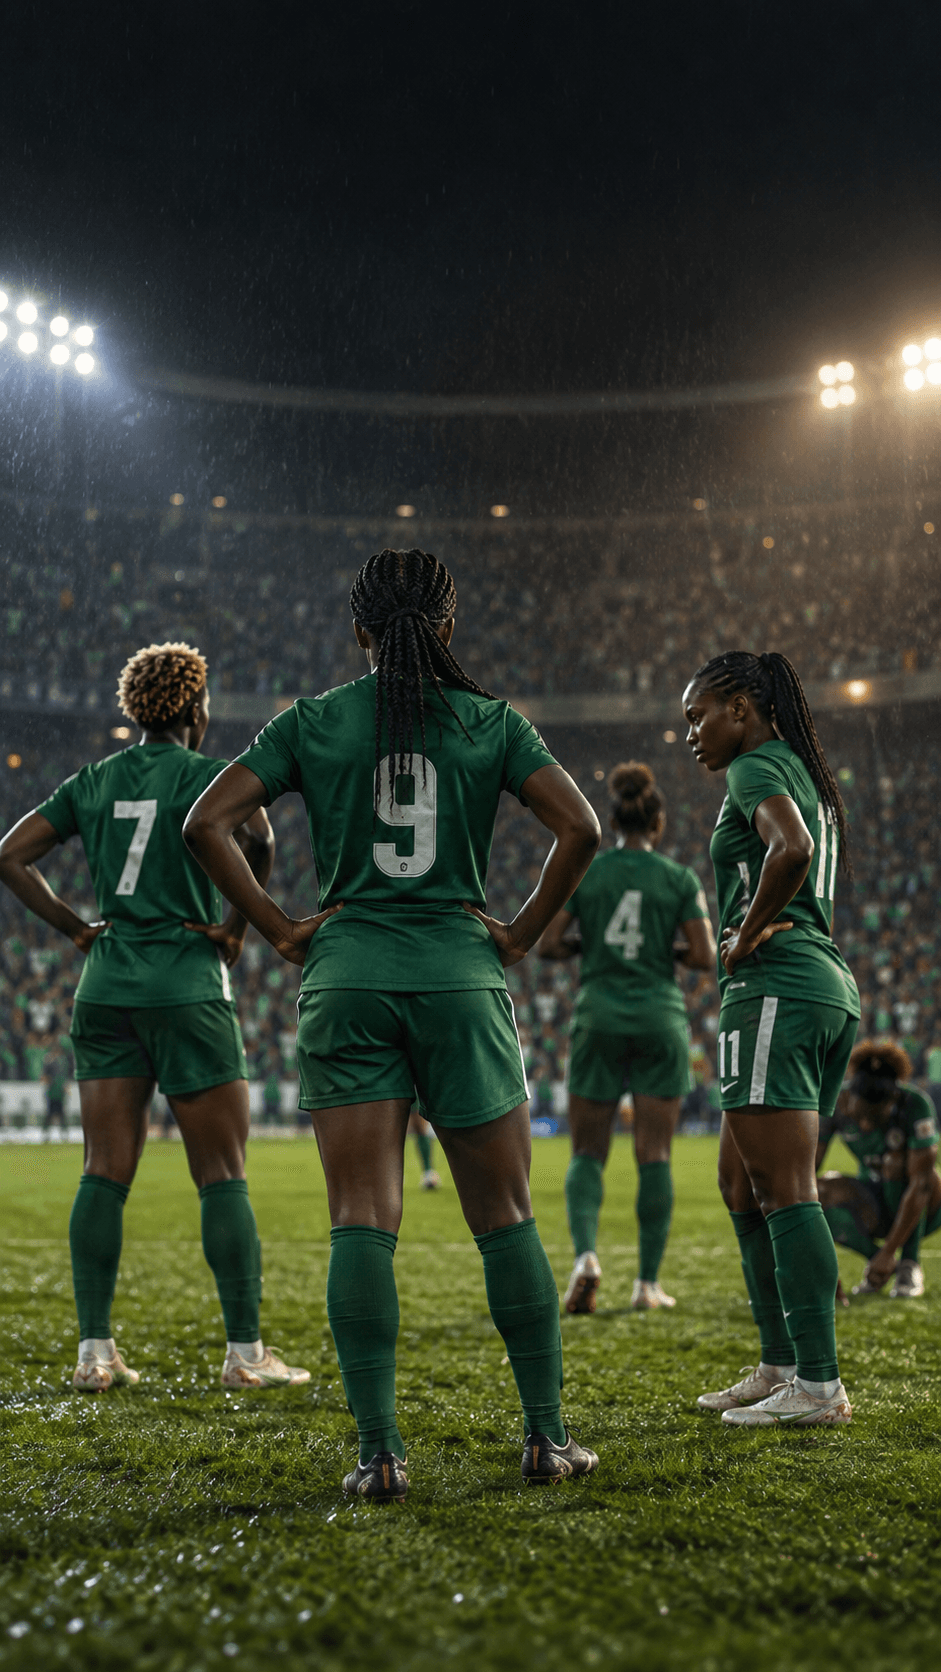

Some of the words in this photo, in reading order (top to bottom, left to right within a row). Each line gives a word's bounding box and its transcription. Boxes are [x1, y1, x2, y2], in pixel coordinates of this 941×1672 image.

[113, 799, 157, 895] 7
[373, 753, 437, 877] 9
[816, 801, 838, 901] 11
[604, 889, 644, 960] 4
[718, 1030, 740, 1078] 11
